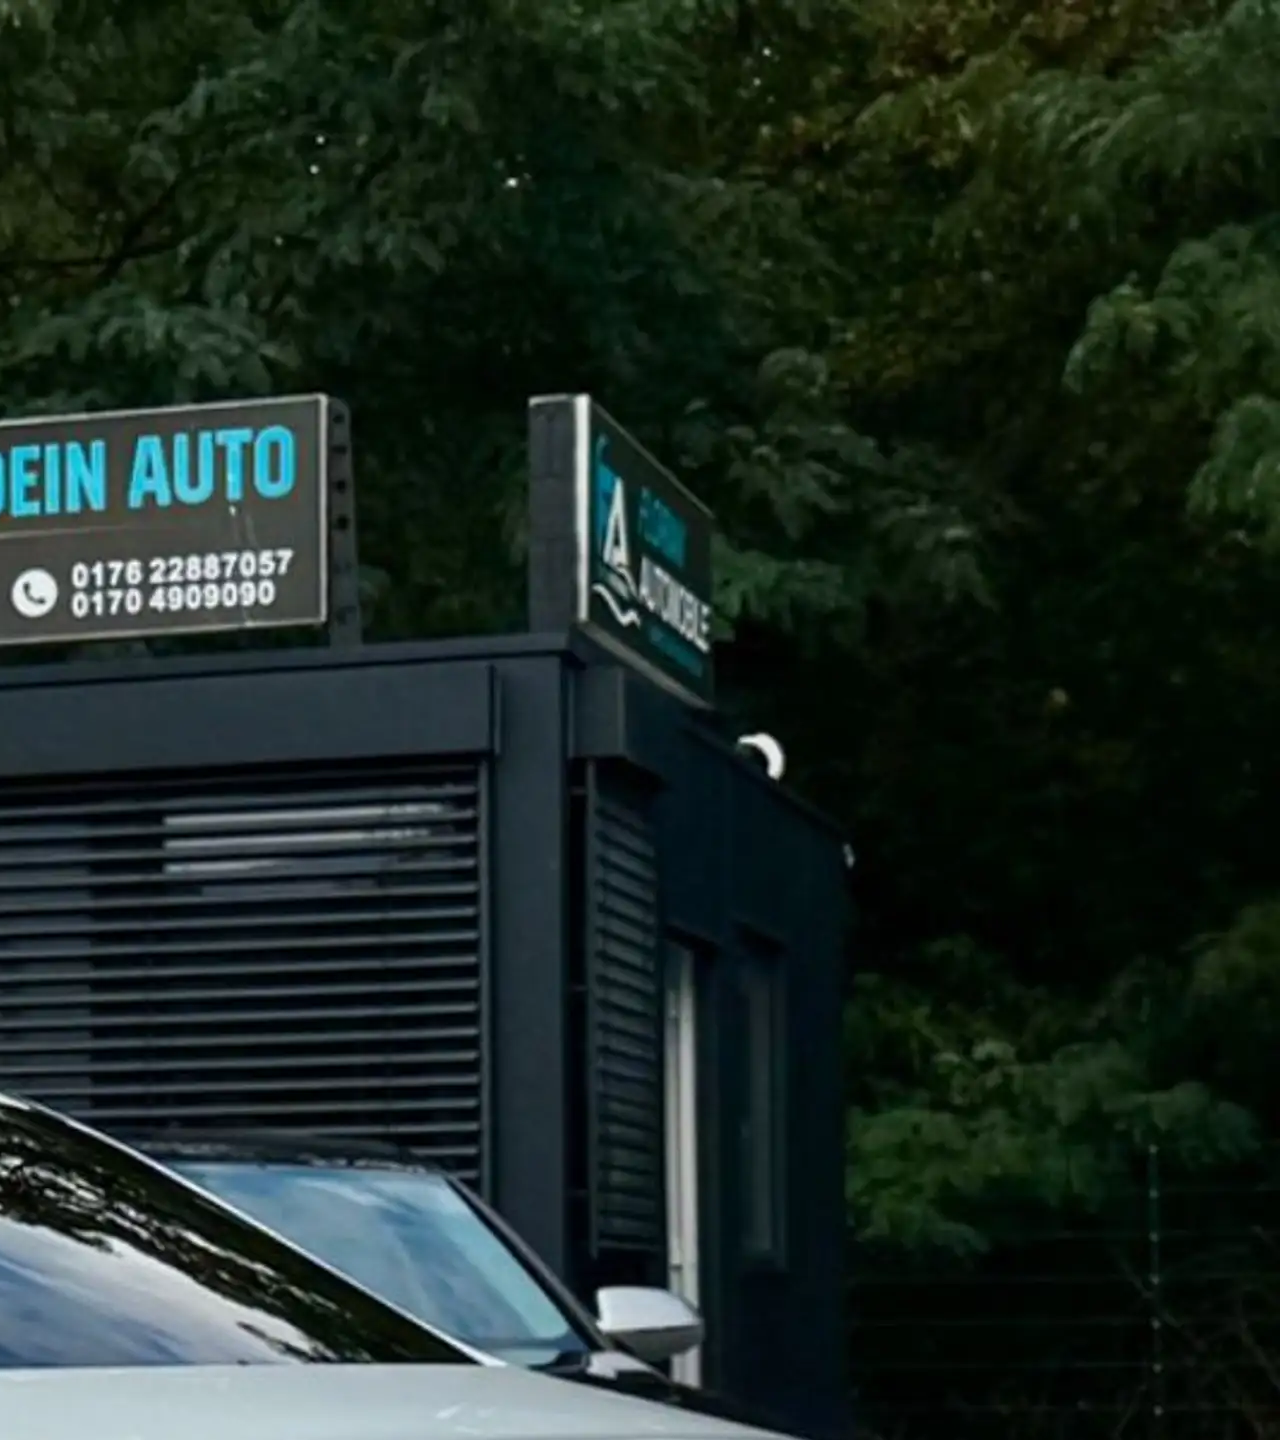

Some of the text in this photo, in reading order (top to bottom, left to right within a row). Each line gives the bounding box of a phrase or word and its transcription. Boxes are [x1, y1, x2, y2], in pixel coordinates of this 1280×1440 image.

[127, 424, 297, 509] AUTO
[71, 548, 294, 590] 0176 22887057
[71, 579, 277, 618] 0170 4909090
